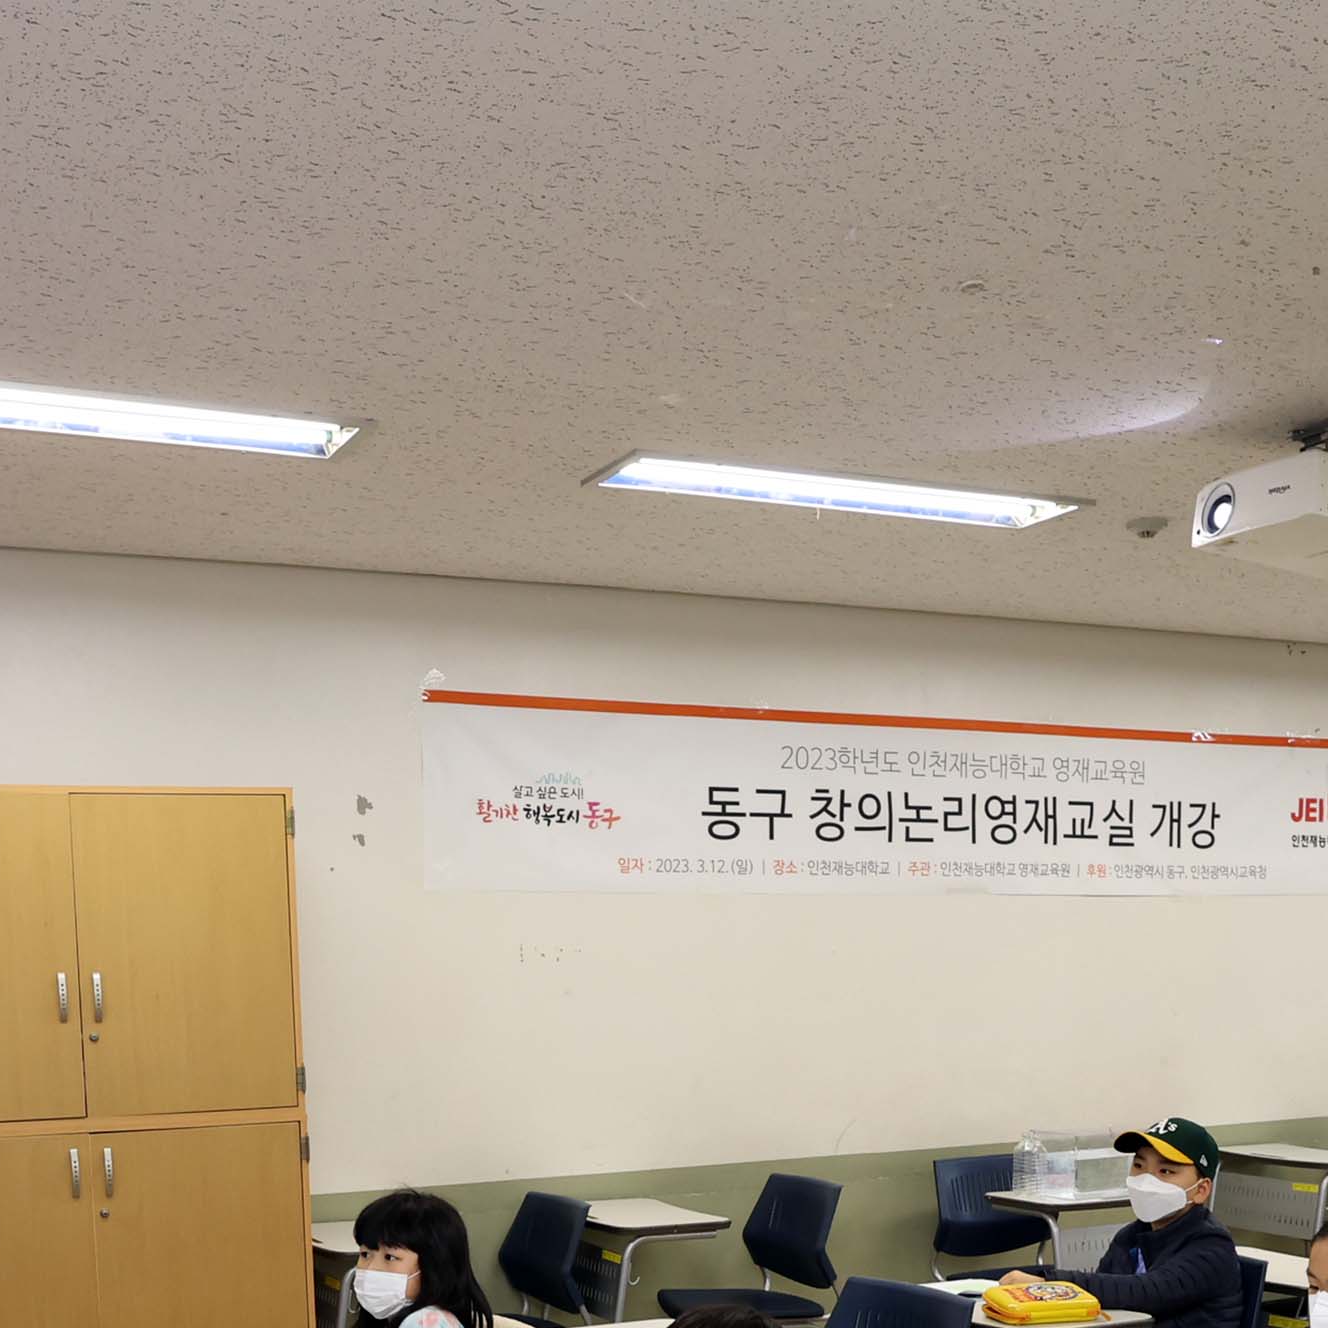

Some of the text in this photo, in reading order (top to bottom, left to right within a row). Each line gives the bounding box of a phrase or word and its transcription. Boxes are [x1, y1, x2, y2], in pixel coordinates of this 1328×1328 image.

[780, 745, 1145, 786] 2023학년도 인천재능대학교 영재교육원
[512, 785, 534, 799] 살고
[536, 786, 557, 800] 싶은
[476, 799, 621, 830] 활기찬 행복도시 동구
[701, 786, 1221, 850] 동구 창의논리영재교실 개강
[807, 859, 891, 877] 인천재능대학교
[940, 861, 1017, 877] 인천재능대학교
[1018, 861, 1071, 878] 영재교육원
[1114, 863, 1164, 879] 인천광역시
[1190, 864, 1268, 881] 인천광역시교육청
